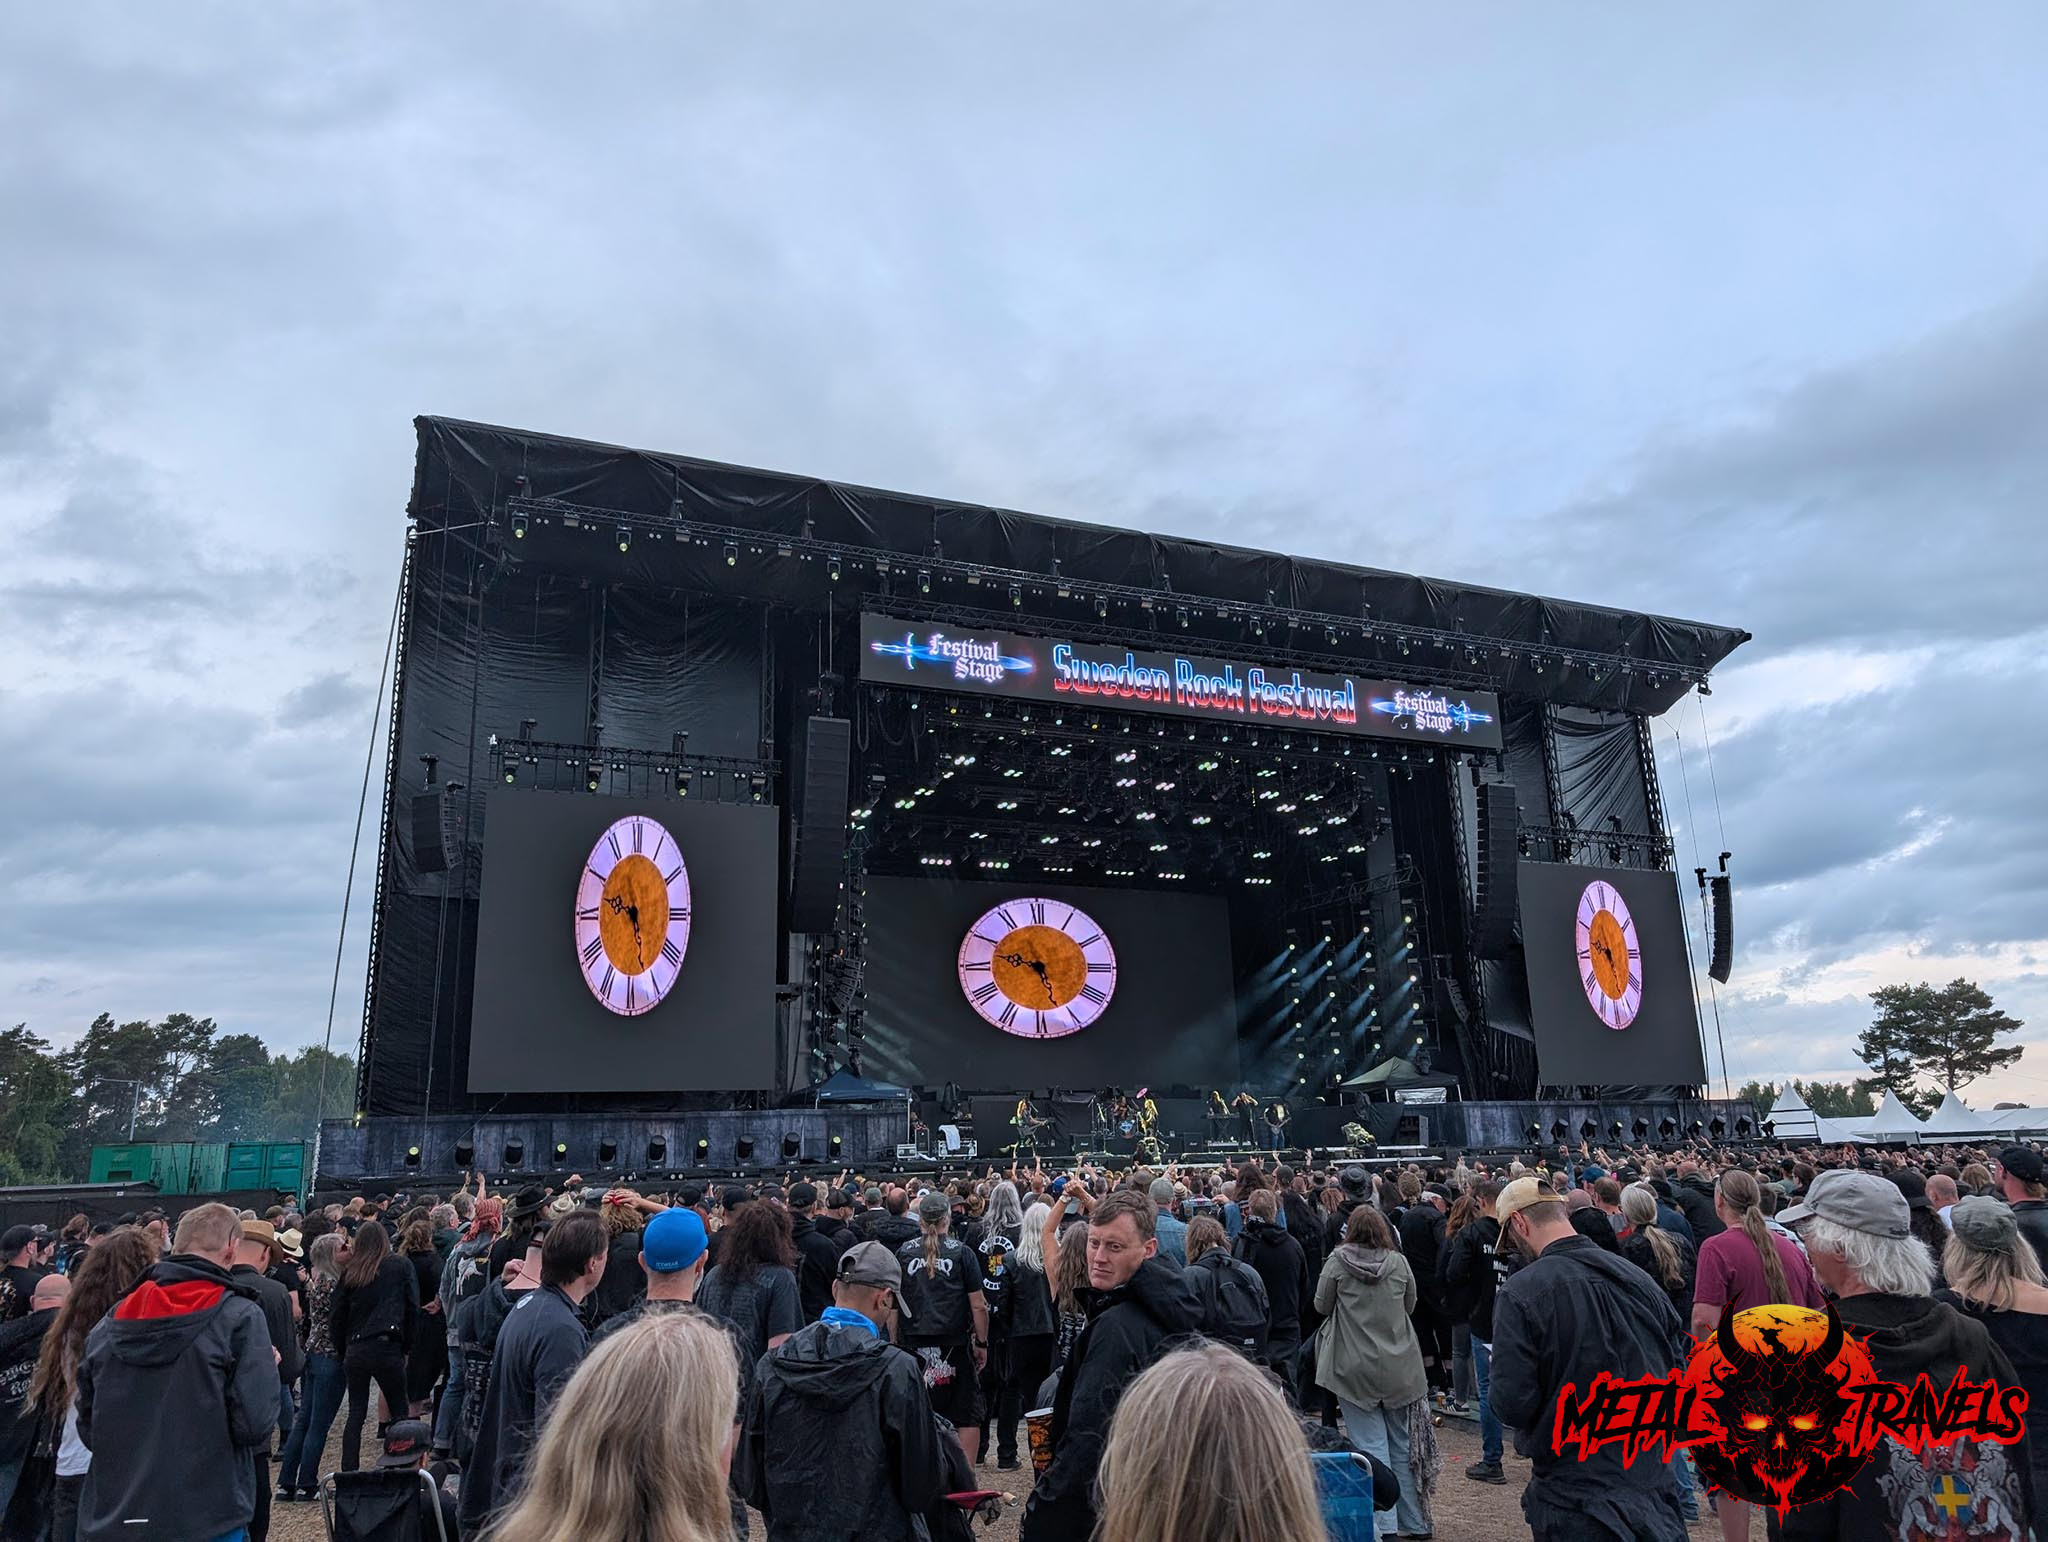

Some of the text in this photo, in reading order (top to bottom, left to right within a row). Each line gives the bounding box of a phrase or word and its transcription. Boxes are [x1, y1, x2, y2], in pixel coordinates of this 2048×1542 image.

[928, 633, 999, 662] Festival
[954, 655, 1004, 683] Stage
[1053, 644, 1356, 725] Sweden Rock Festival
[1394, 690, 1449, 715] Festival
[1415, 711, 1453, 732] Stage
